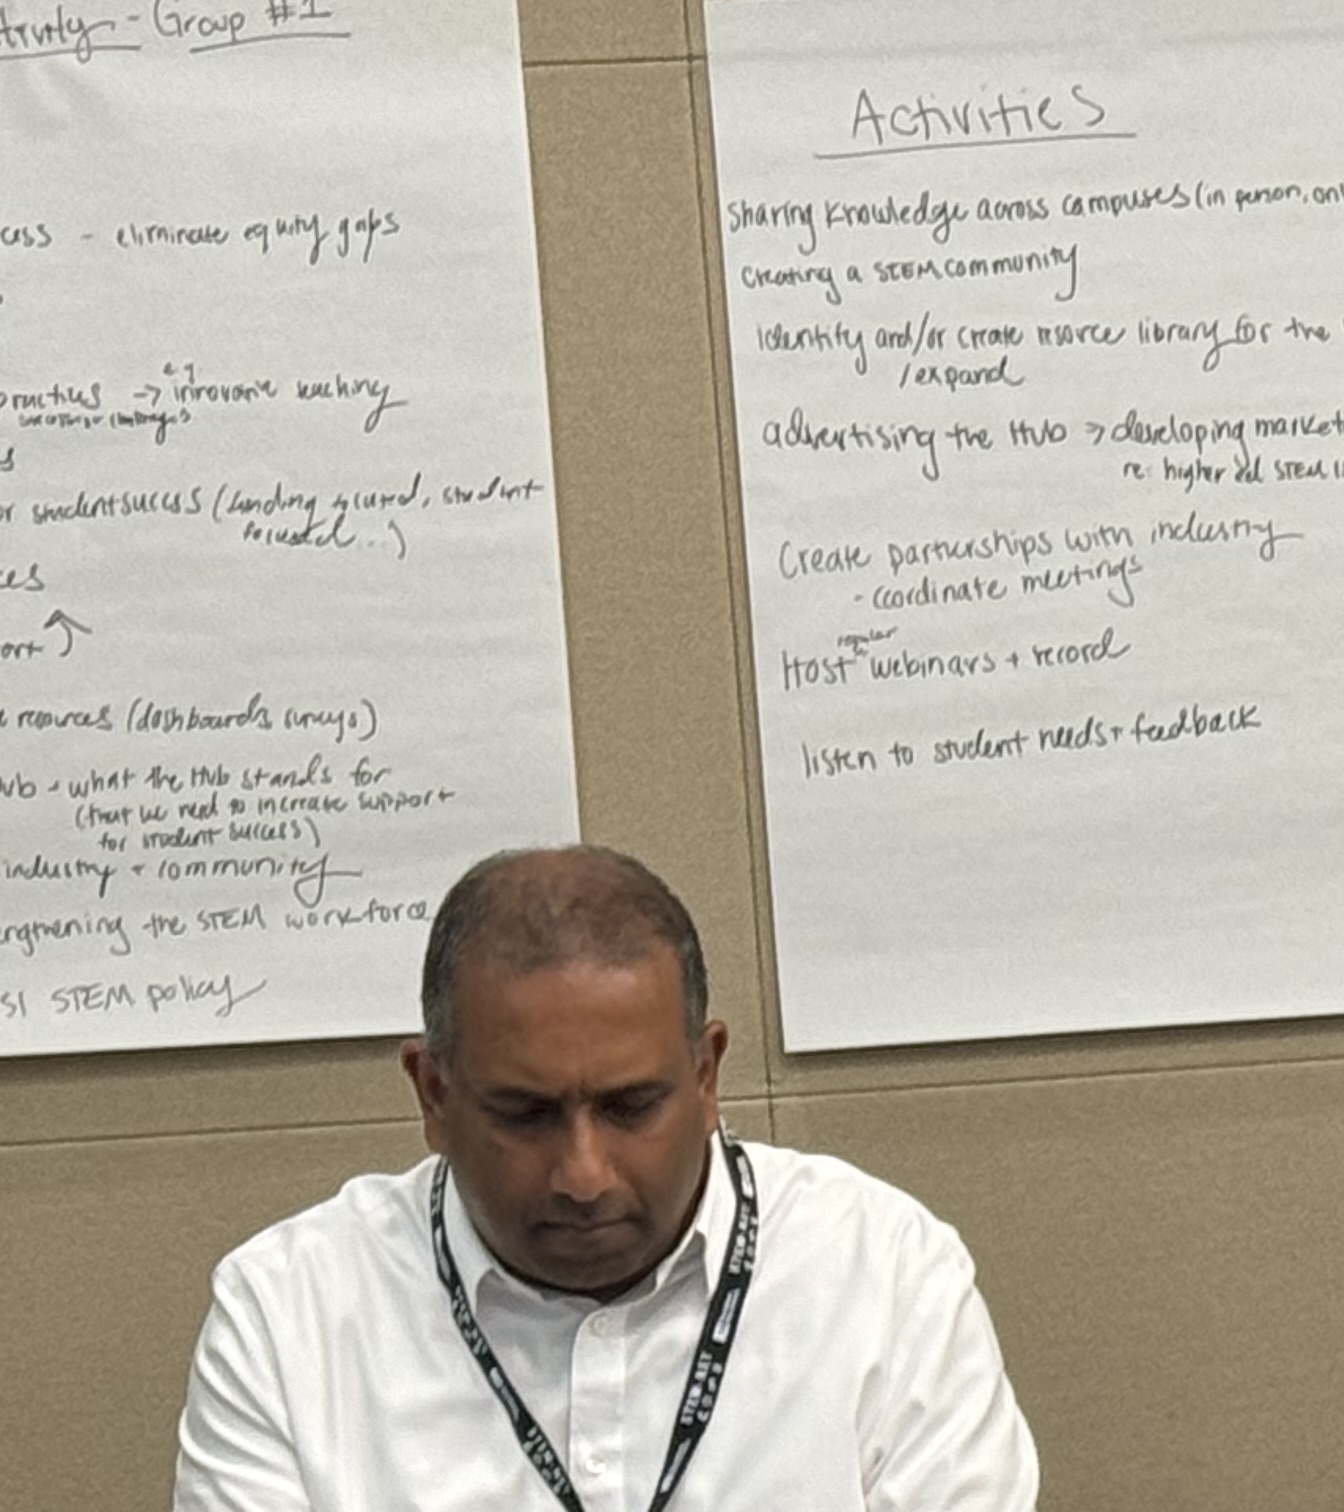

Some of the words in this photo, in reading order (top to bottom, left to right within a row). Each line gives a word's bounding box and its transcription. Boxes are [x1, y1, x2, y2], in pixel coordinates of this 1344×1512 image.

[153, 0, 246, 38] Group
[851, 83, 1107, 146] Activities
[846, 265, 864, 284] a
[1285, 316, 1332, 343] the
[945, 421, 995, 451] the
[1008, 419, 1069, 449] Hub
[778, 539, 873, 582] Create
[1064, 522, 1134, 555] with
[887, 739, 915, 767] to
[933, 726, 1031, 765] student
[1129, 702, 1264, 744] feedback
[145, 765, 184, 793] the
[241, 752, 333, 788] stands
[350, 756, 391, 787] for
[142, 917, 188, 940] the
[196, 903, 268, 931] STEM
[52, 983, 136, 1015] STEM
[146, 974, 268, 1018] policy
